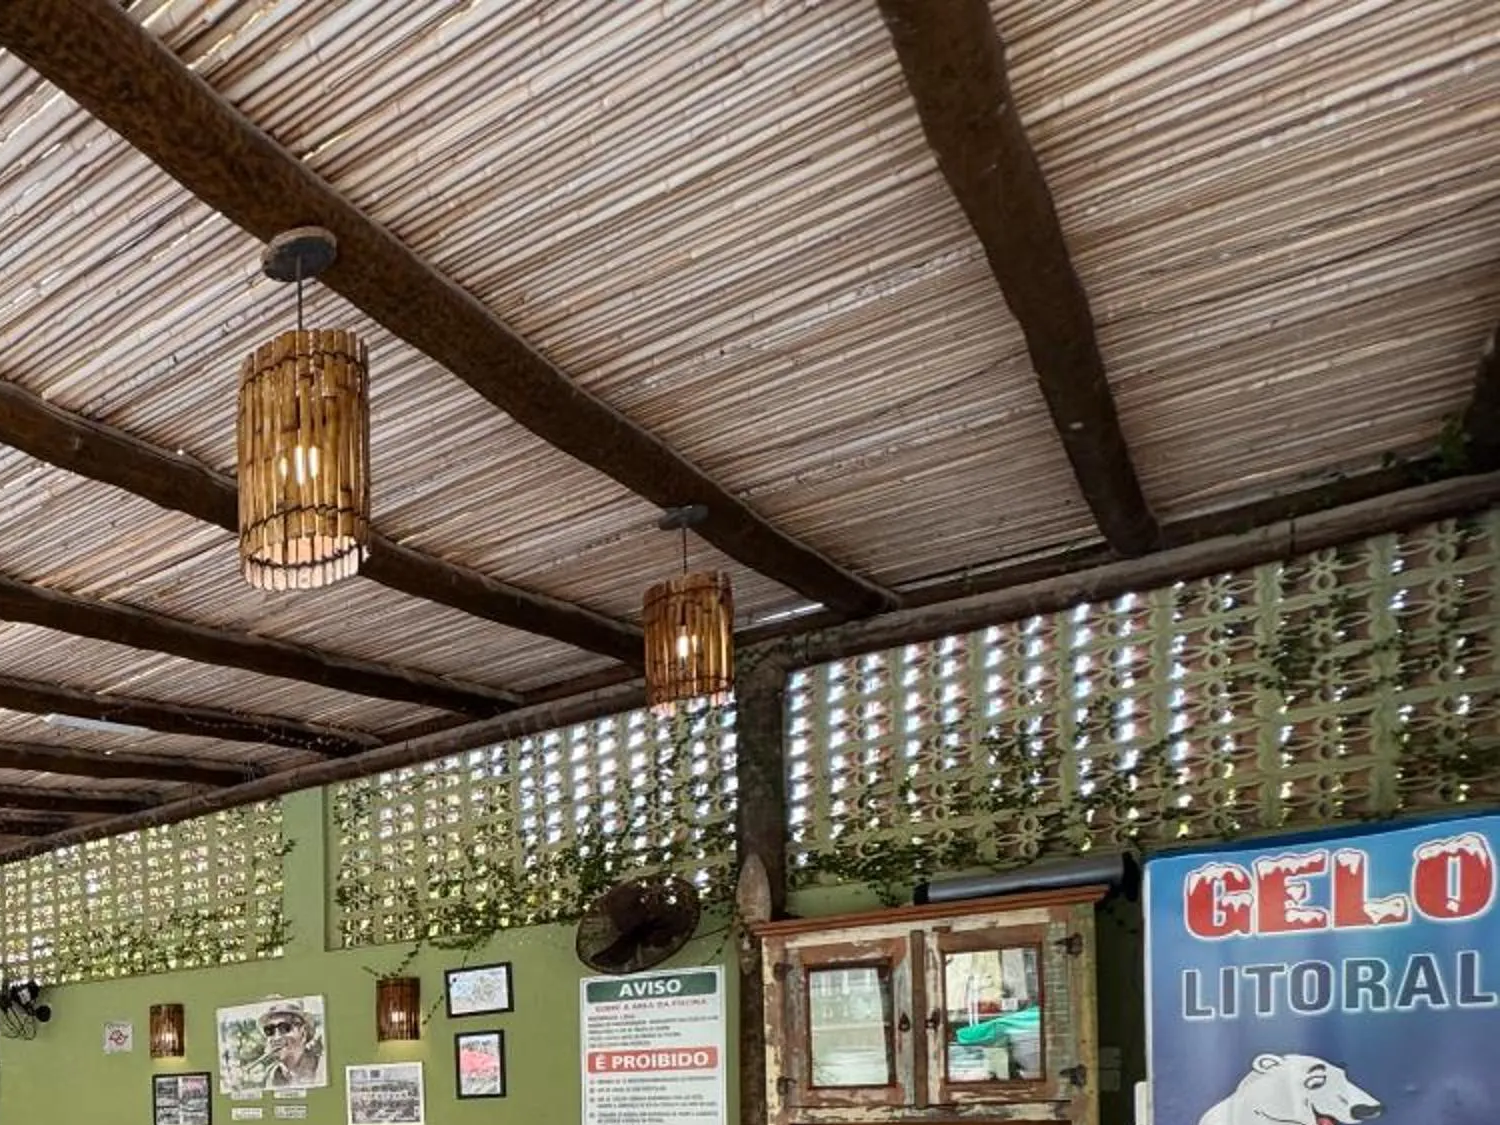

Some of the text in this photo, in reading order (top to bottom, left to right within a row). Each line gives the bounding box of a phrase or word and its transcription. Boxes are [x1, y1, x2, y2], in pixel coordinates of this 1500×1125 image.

[1184, 832, 1497, 940] GELO
[619, 979, 682, 998] AVISO
[1181, 950, 1498, 1020] LITORAL
[611, 1051, 709, 1070] PROIBIDO
